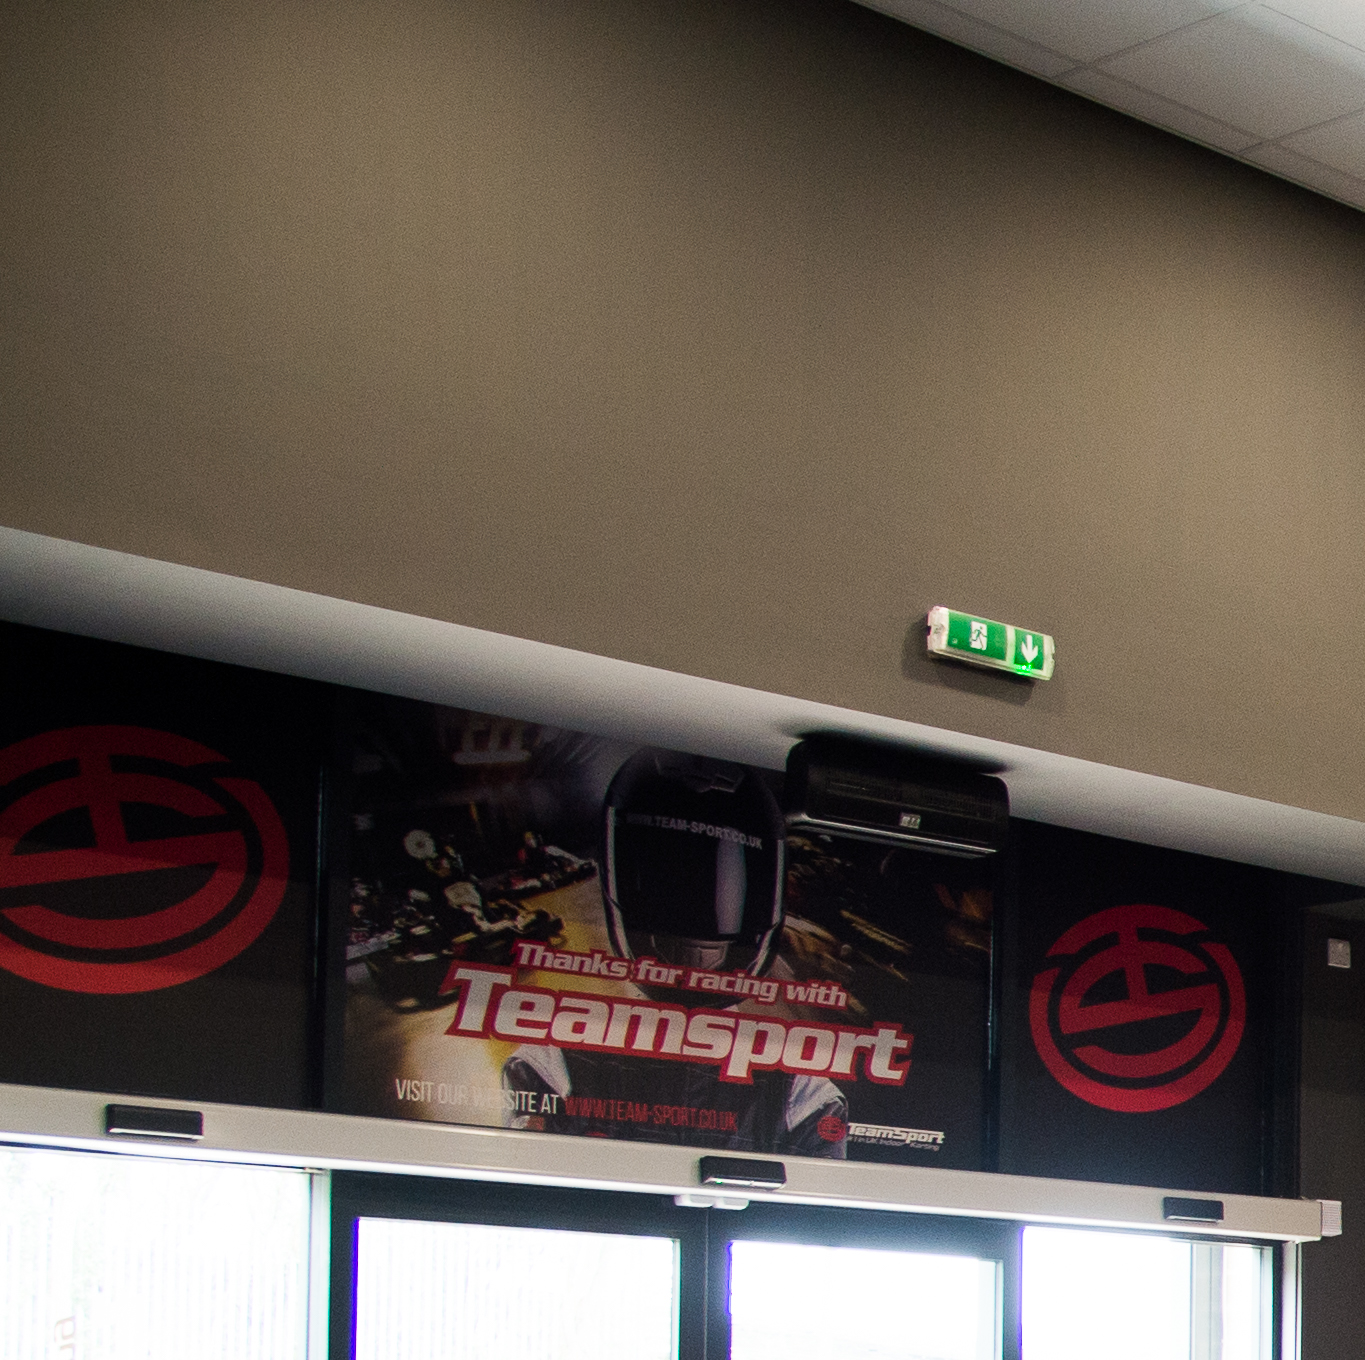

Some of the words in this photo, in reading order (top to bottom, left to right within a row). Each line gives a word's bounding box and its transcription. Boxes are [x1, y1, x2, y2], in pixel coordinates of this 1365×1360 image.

[515, 942, 627, 982] Thanks
[636, 960, 683, 985] for
[689, 972, 779, 1001] racing
[786, 980, 847, 1007] with
[453, 967, 908, 1081] Teamsport
[395, 1078, 435, 1103] VISIT
[438, 1082, 470, 1105] OUR
[540, 1093, 560, 1115] AT
[848, 1122, 946, 1144] TeamSport
